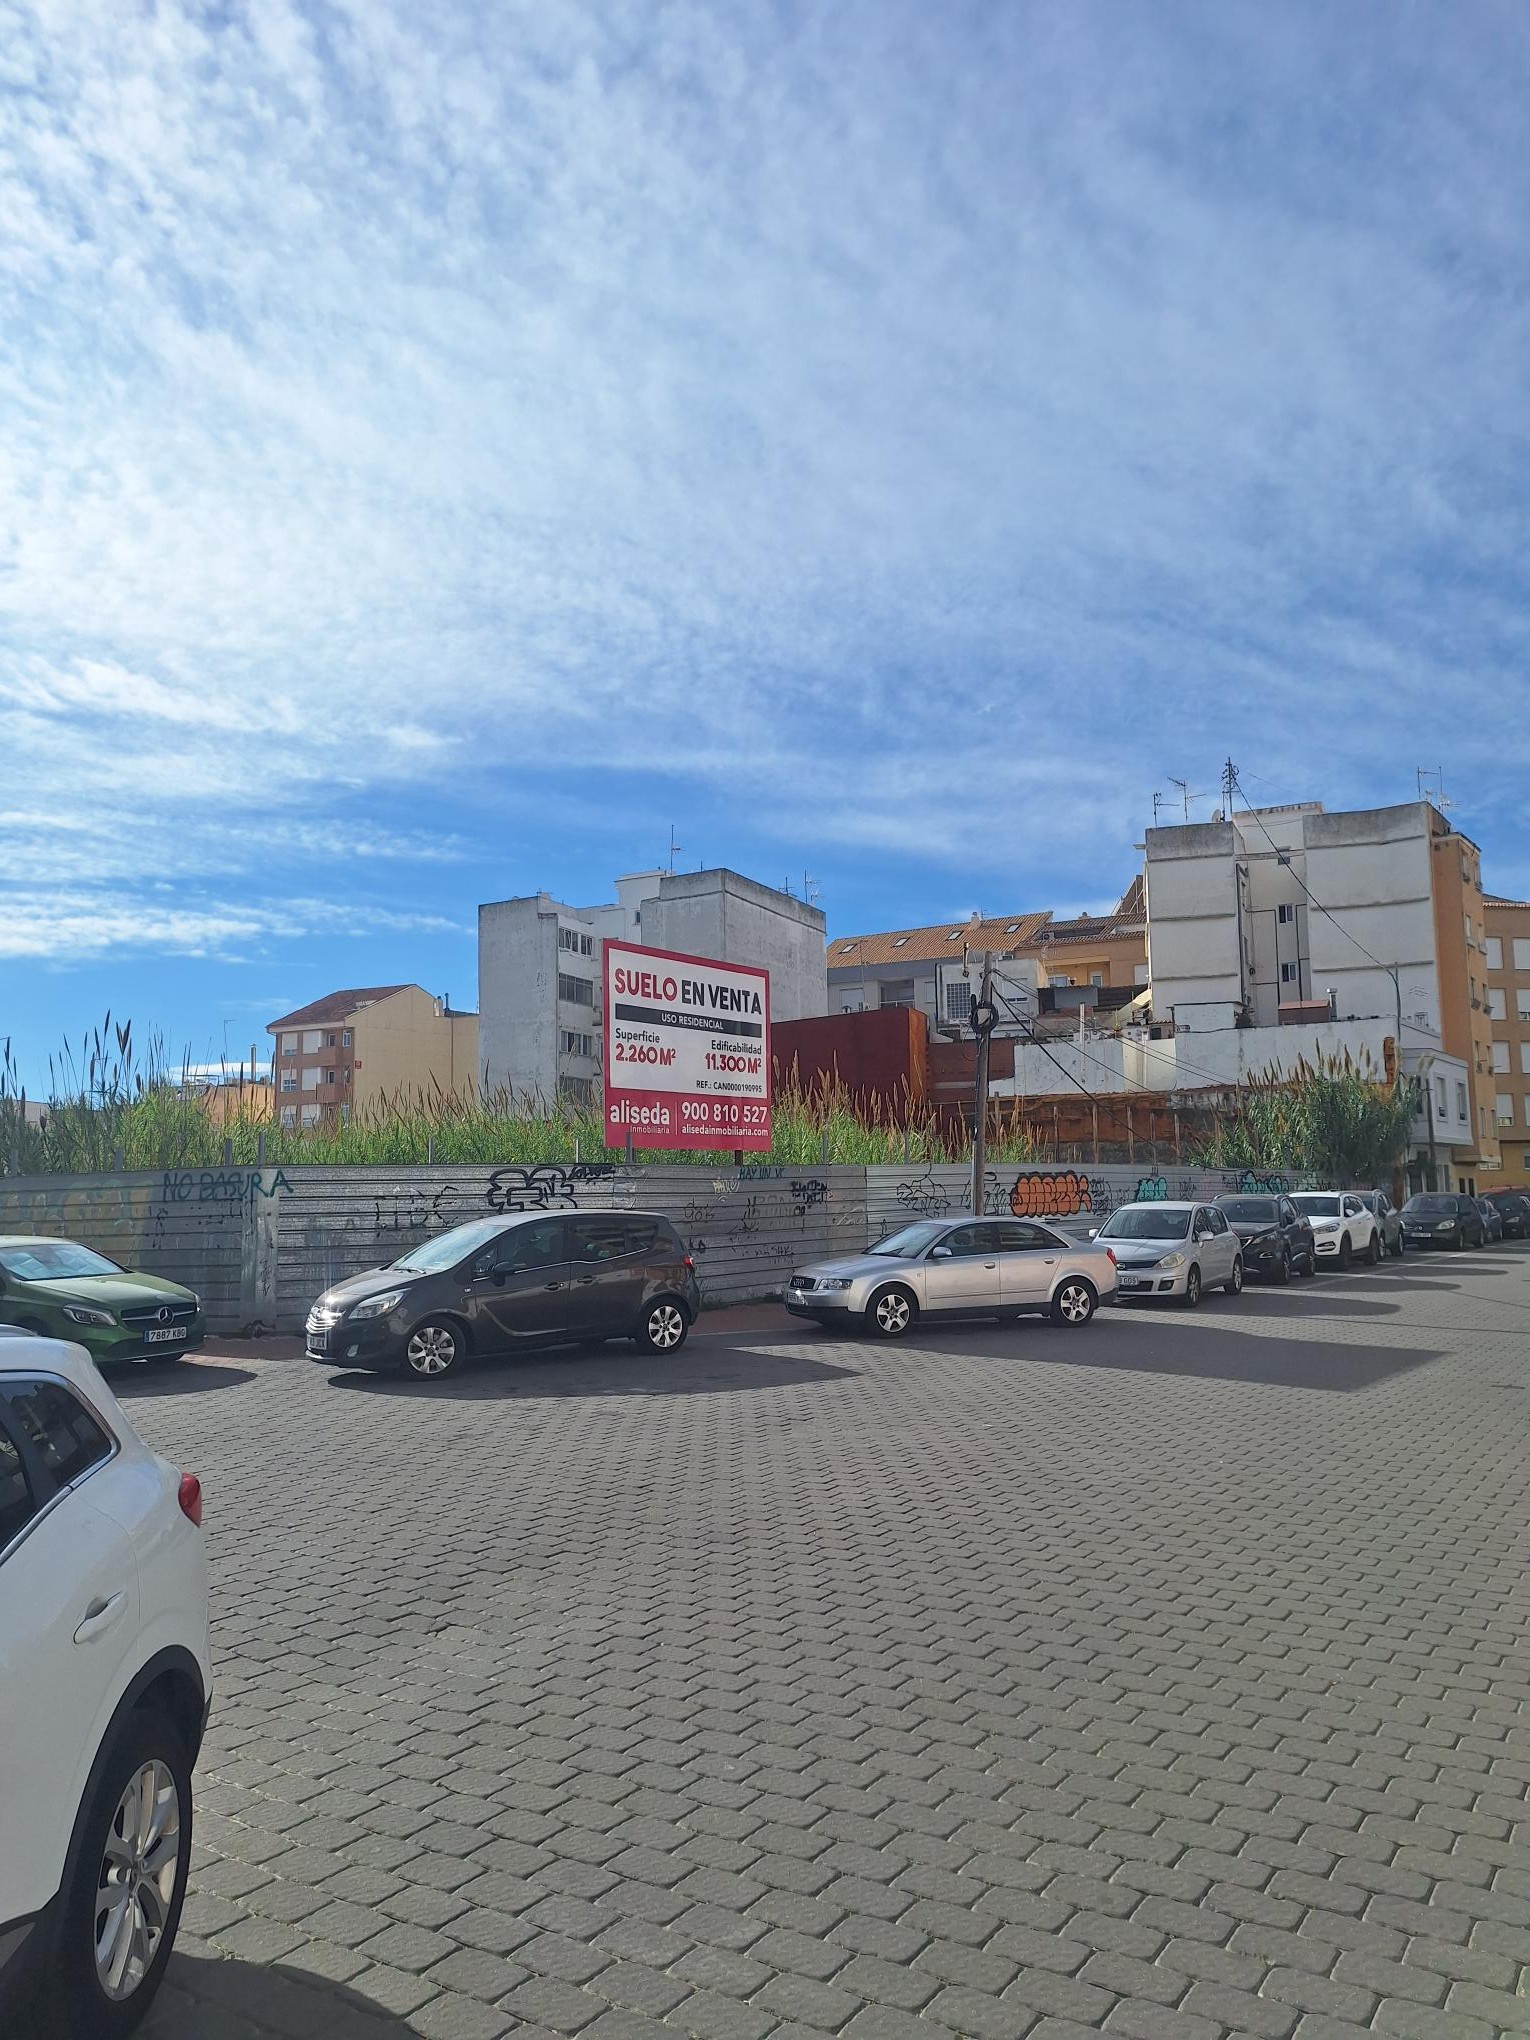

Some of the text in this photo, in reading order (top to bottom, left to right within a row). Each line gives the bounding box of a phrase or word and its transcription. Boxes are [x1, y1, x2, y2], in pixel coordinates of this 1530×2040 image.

[614, 967, 762, 1015] SUELO EN VENTA
[661, 1012, 724, 1031] USO RESIDENCIAL
[615, 1027, 661, 1044] Superficie
[615, 1042, 658, 1065] 2.260
[711, 1039, 762, 1055] Edificabilidad
[705, 1052, 747, 1073] 11.300
[696, 1080, 712, 1090] REF.:
[610, 1099, 670, 1126] aliseda
[681, 1101, 768, 1124] 900 810 527
[681, 1123, 769, 1138] alisedainmobiliaria.com
[163, 1172, 193, 1201] NO
